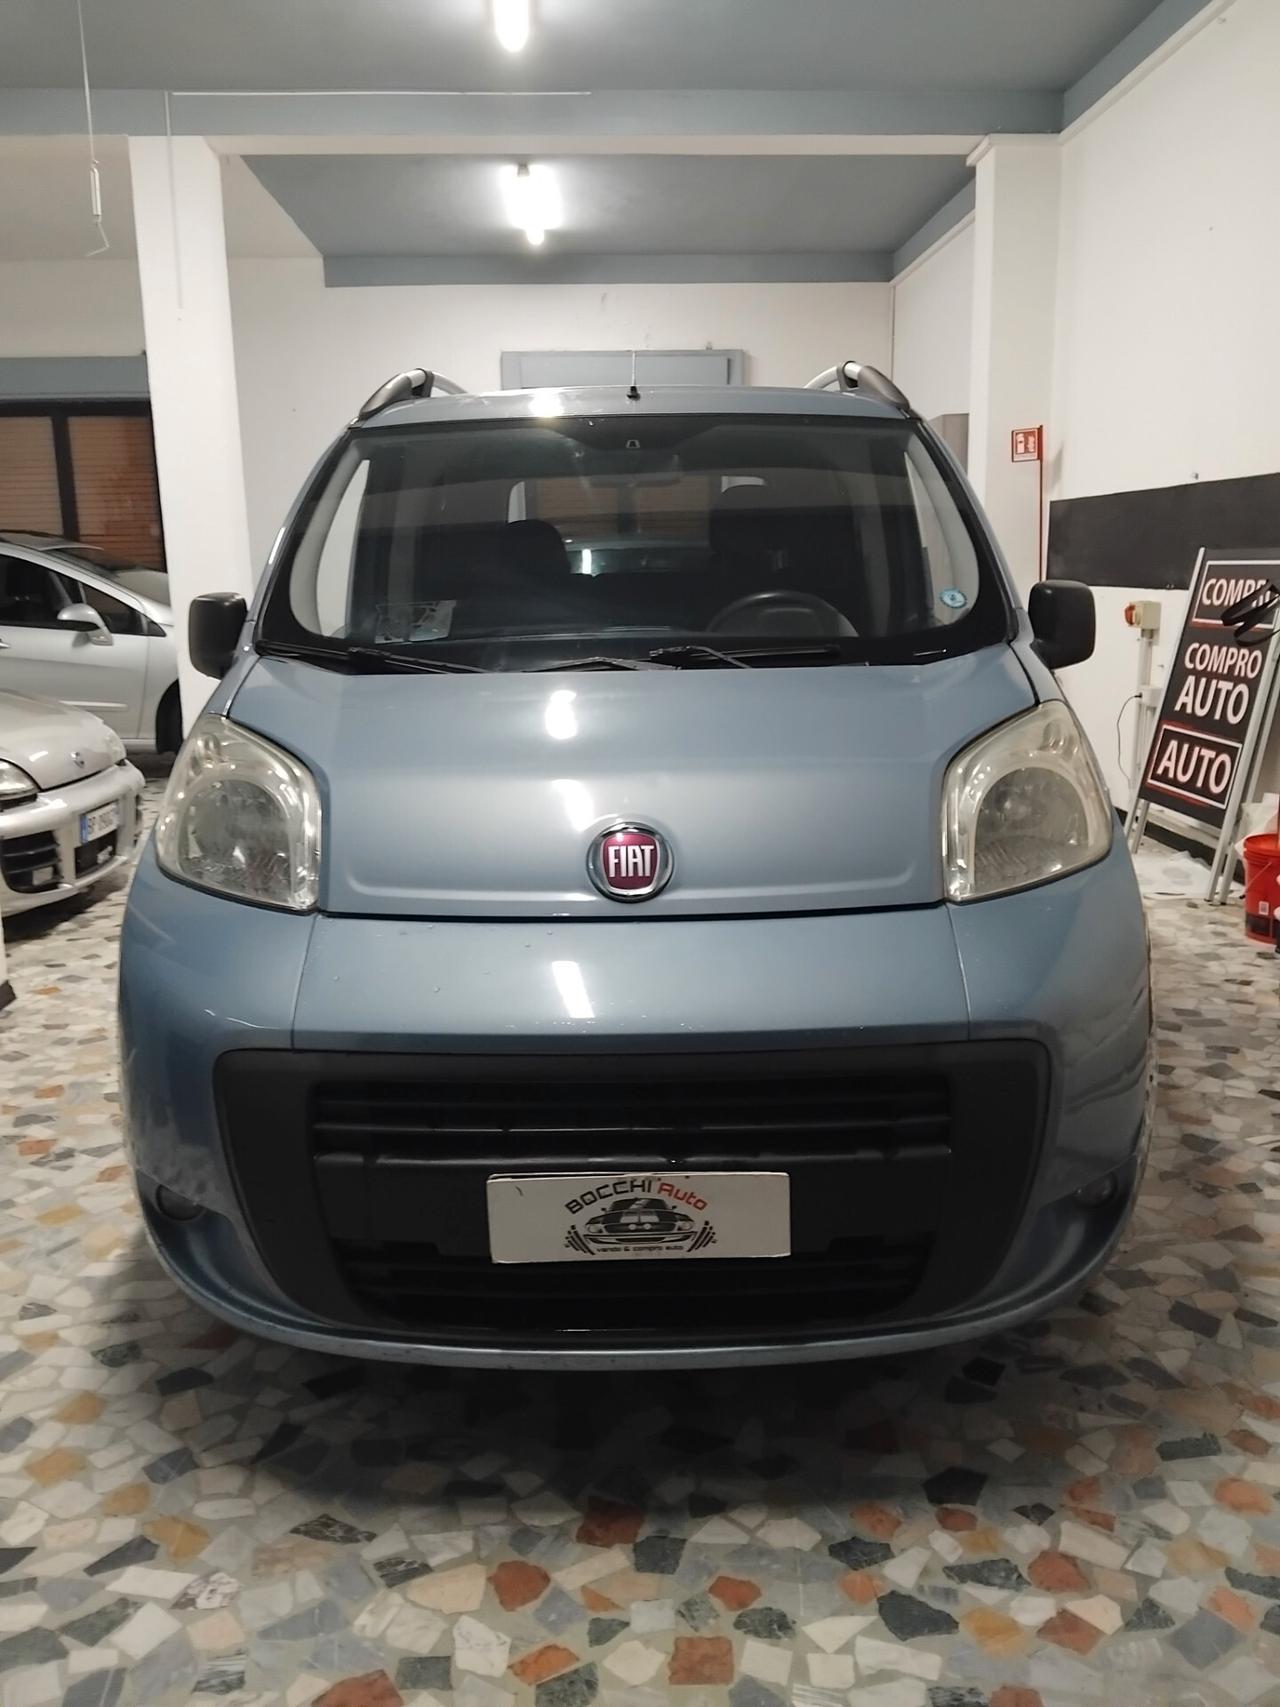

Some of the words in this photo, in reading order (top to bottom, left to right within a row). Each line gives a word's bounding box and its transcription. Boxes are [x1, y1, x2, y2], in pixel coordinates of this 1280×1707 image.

[1202, 578, 1272, 607] COMPR
[1184, 642, 1263, 679] COMPRO
[1174, 675, 1250, 725] AUTO
[1156, 738, 1232, 794] AUTO
[608, 844, 655, 878] FIAT
[564, 1178, 653, 1214] BOCCHI
[657, 1181, 708, 1211] Auto
